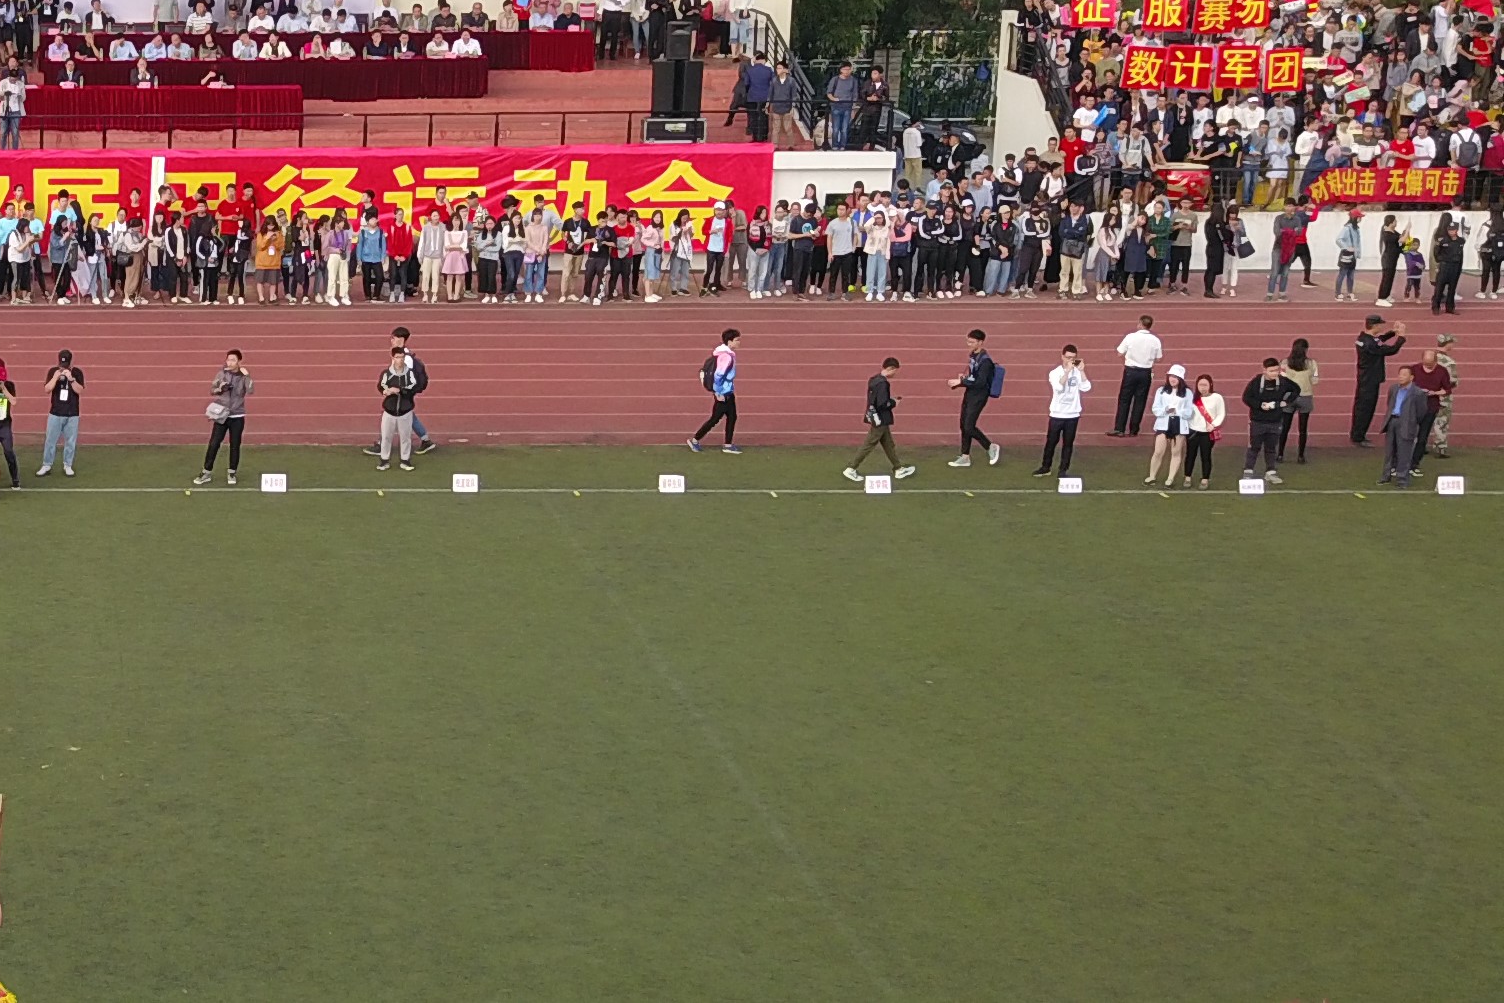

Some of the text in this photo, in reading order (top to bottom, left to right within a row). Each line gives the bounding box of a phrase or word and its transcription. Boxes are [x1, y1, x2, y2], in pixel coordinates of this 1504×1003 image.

[1127, 49, 1300, 90] 数计军团
[1386, 168, 1460, 197] 无懈可击
